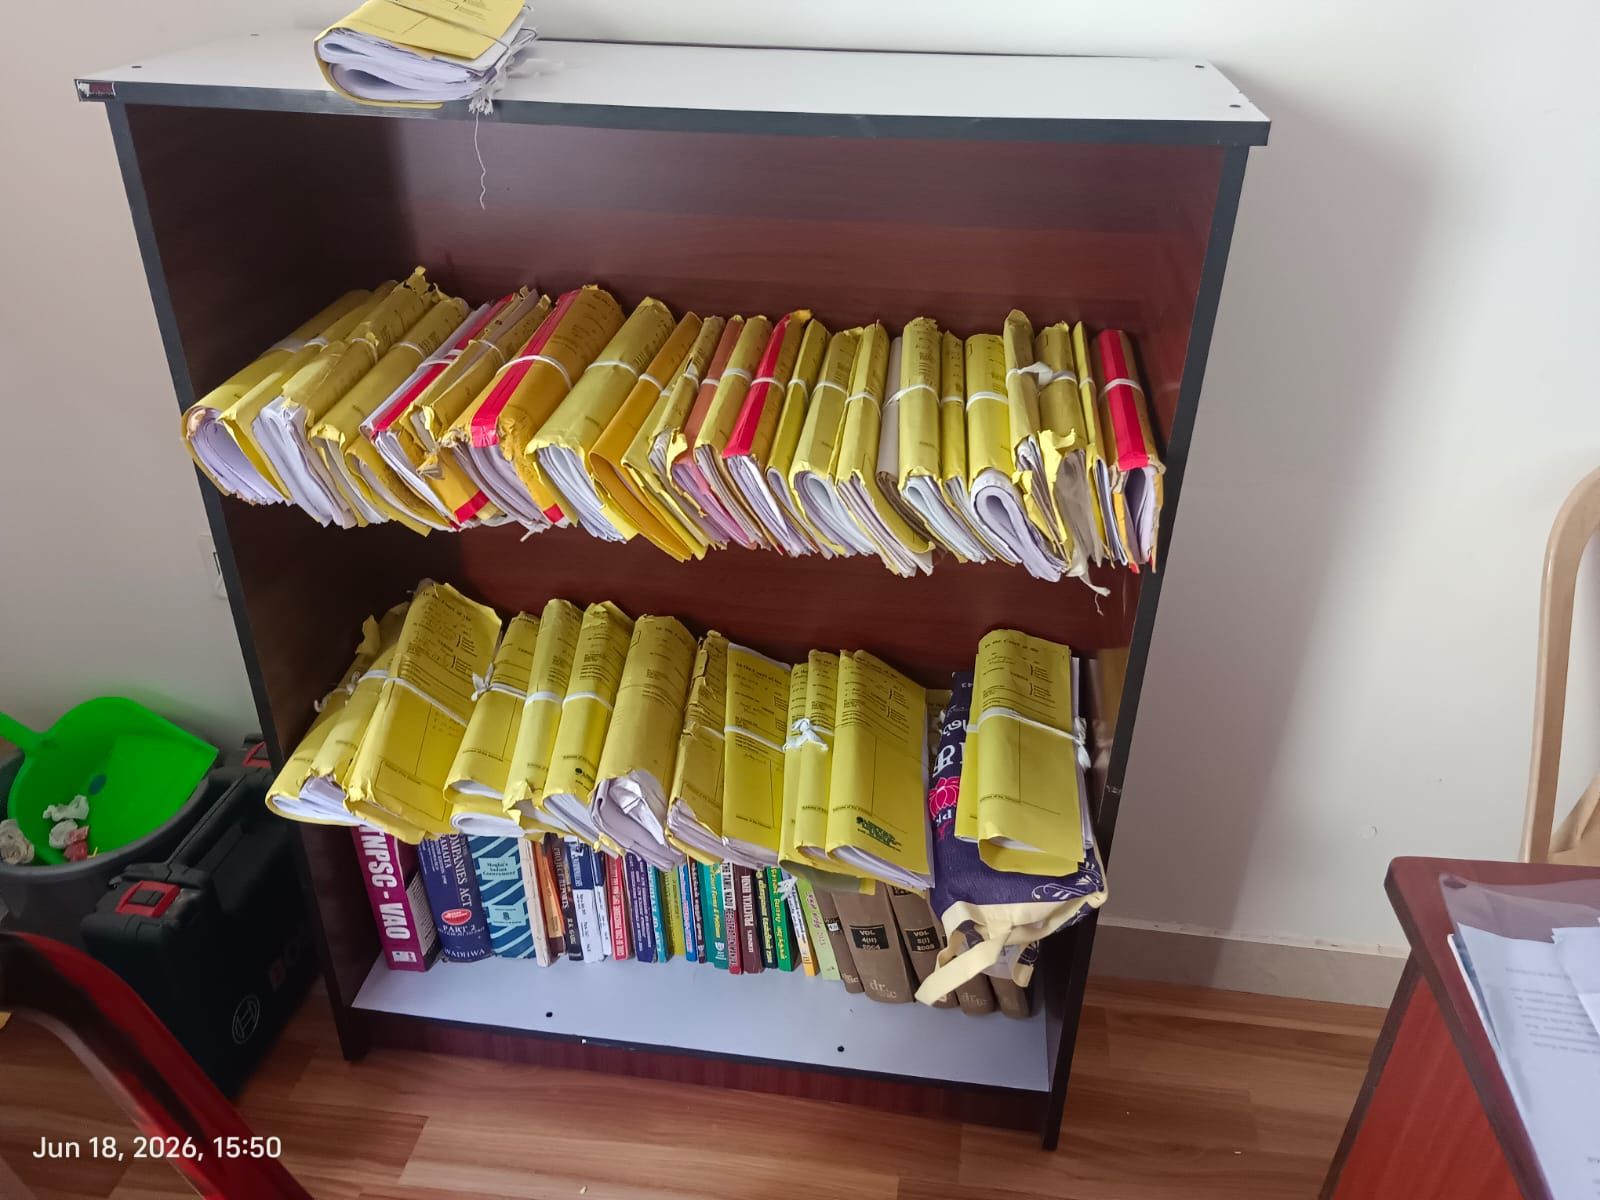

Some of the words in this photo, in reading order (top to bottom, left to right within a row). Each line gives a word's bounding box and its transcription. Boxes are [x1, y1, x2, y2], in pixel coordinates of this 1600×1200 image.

[449, 833, 468, 885] OMPANIES
[459, 887, 473, 907] ACT
[723, 874, 732, 890] TAMIL
[558, 875, 570, 910] REPORTS
[725, 891, 733, 907] NADU
[379, 902, 411, 940] VAO
[742, 894, 755, 927] PRACTICAL
